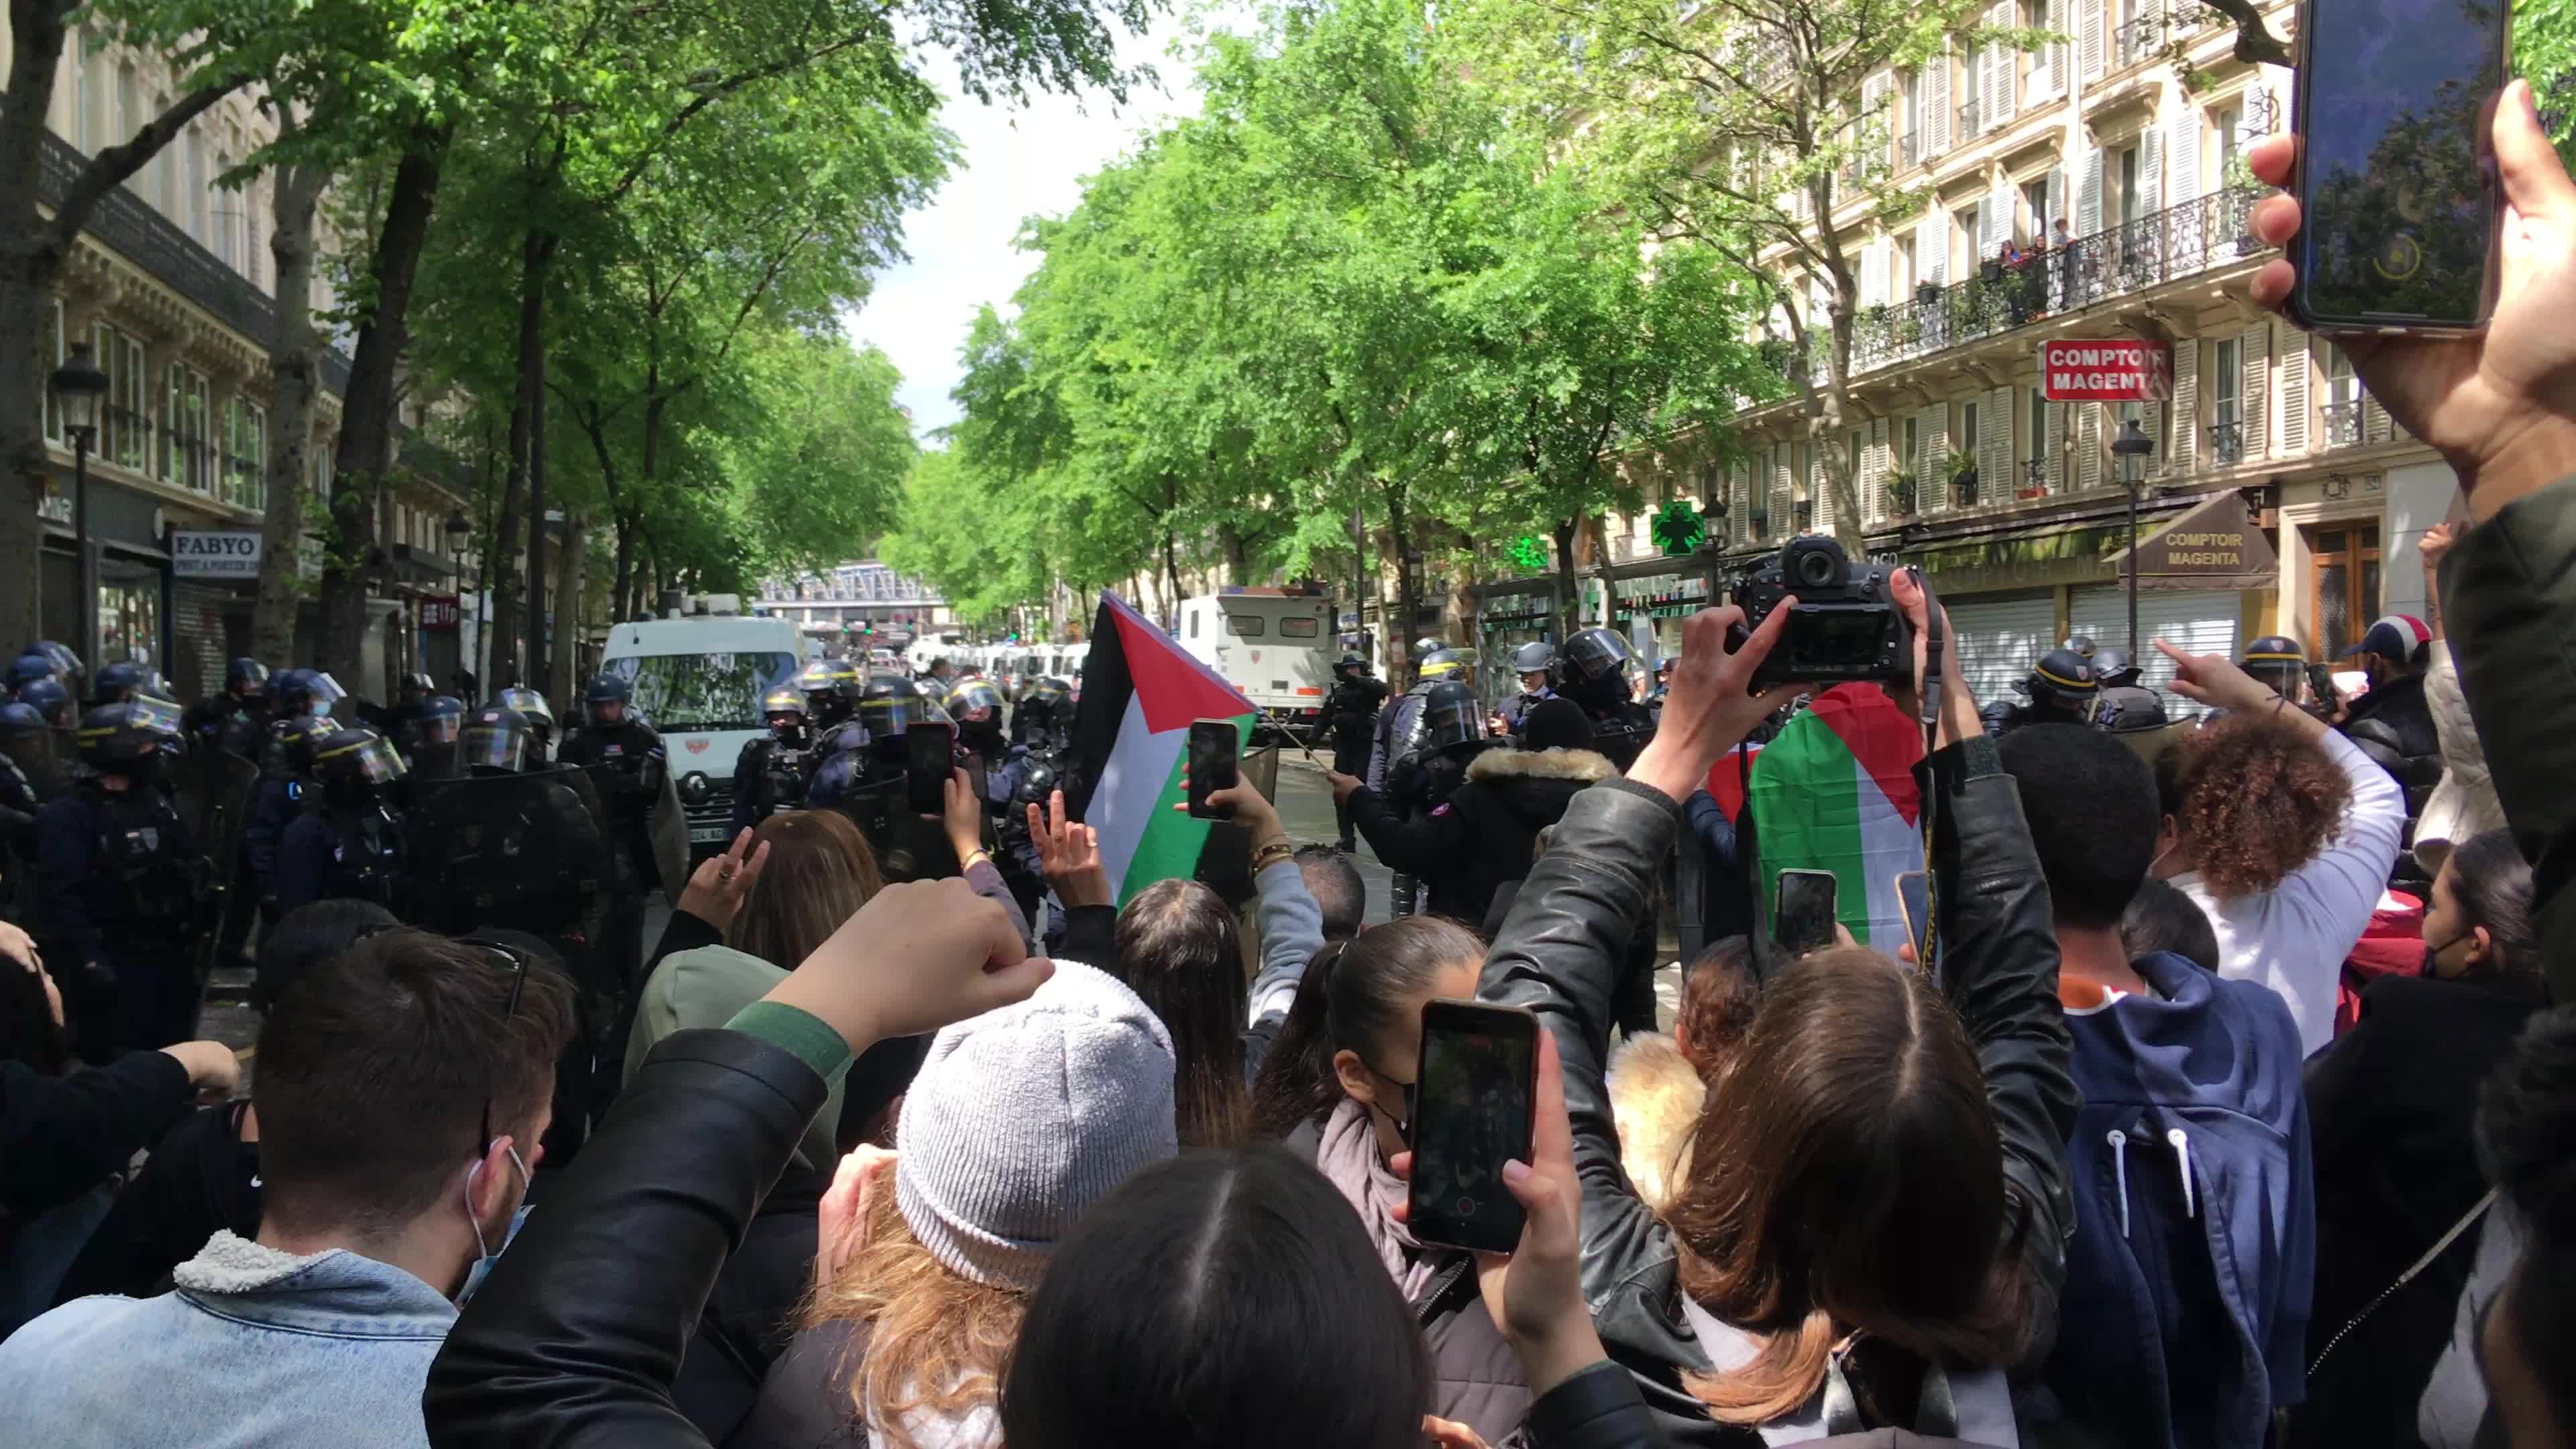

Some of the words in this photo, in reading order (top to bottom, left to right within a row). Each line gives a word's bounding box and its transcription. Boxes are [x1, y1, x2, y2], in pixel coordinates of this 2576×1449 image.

[2049, 349, 2165, 367] COMPTOIR
[2052, 372, 2162, 390] MAGENTA
[176, 536, 255, 555] FABYO
[2165, 533, 2243, 547] COMPTOIR
[2167, 552, 2240, 565] MAGENTA
